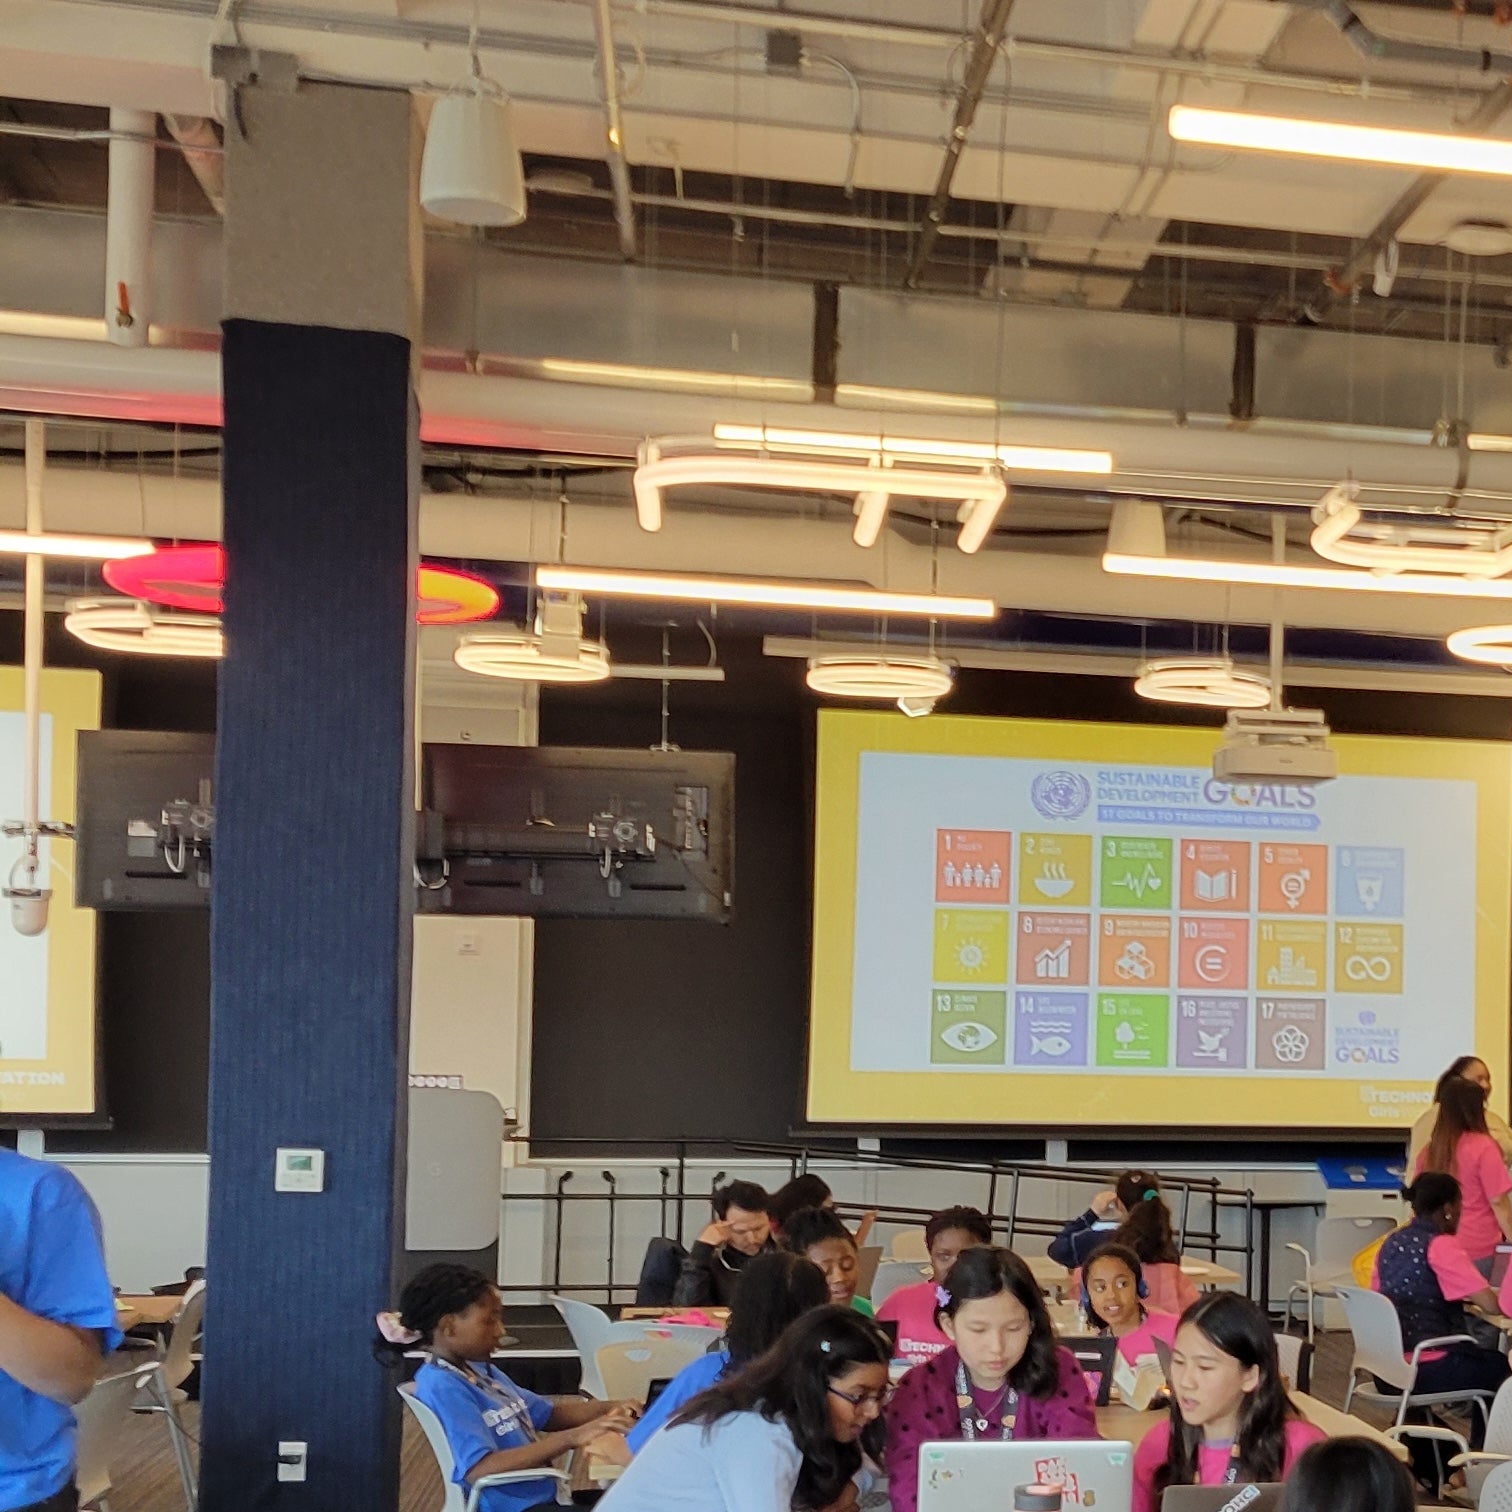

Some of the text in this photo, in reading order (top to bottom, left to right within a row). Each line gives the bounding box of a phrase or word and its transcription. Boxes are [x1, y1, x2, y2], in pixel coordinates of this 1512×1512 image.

[1097, 770, 1200, 789] SUSTAINABLE
[1098, 787, 1199, 803] DEVELOPMENT
[1203, 776, 1317, 809] GOALS
[1023, 916, 1033, 934] 8
[1104, 919, 1114, 936] 9
[1183, 921, 1198, 939] 10
[1262, 924, 1274, 941] 11
[1339, 927, 1353, 944] 12
[936, 994, 952, 1012] 13
[1019, 996, 1034, 1014] 14
[1182, 1000, 1197, 1018] 16
[1261, 1002, 1275, 1020] 17
[1335, 1047, 1400, 1065] GOALS
[0, 1072, 65, 1085] ATION
[1364, 1089, 1435, 1104] TECHNO
